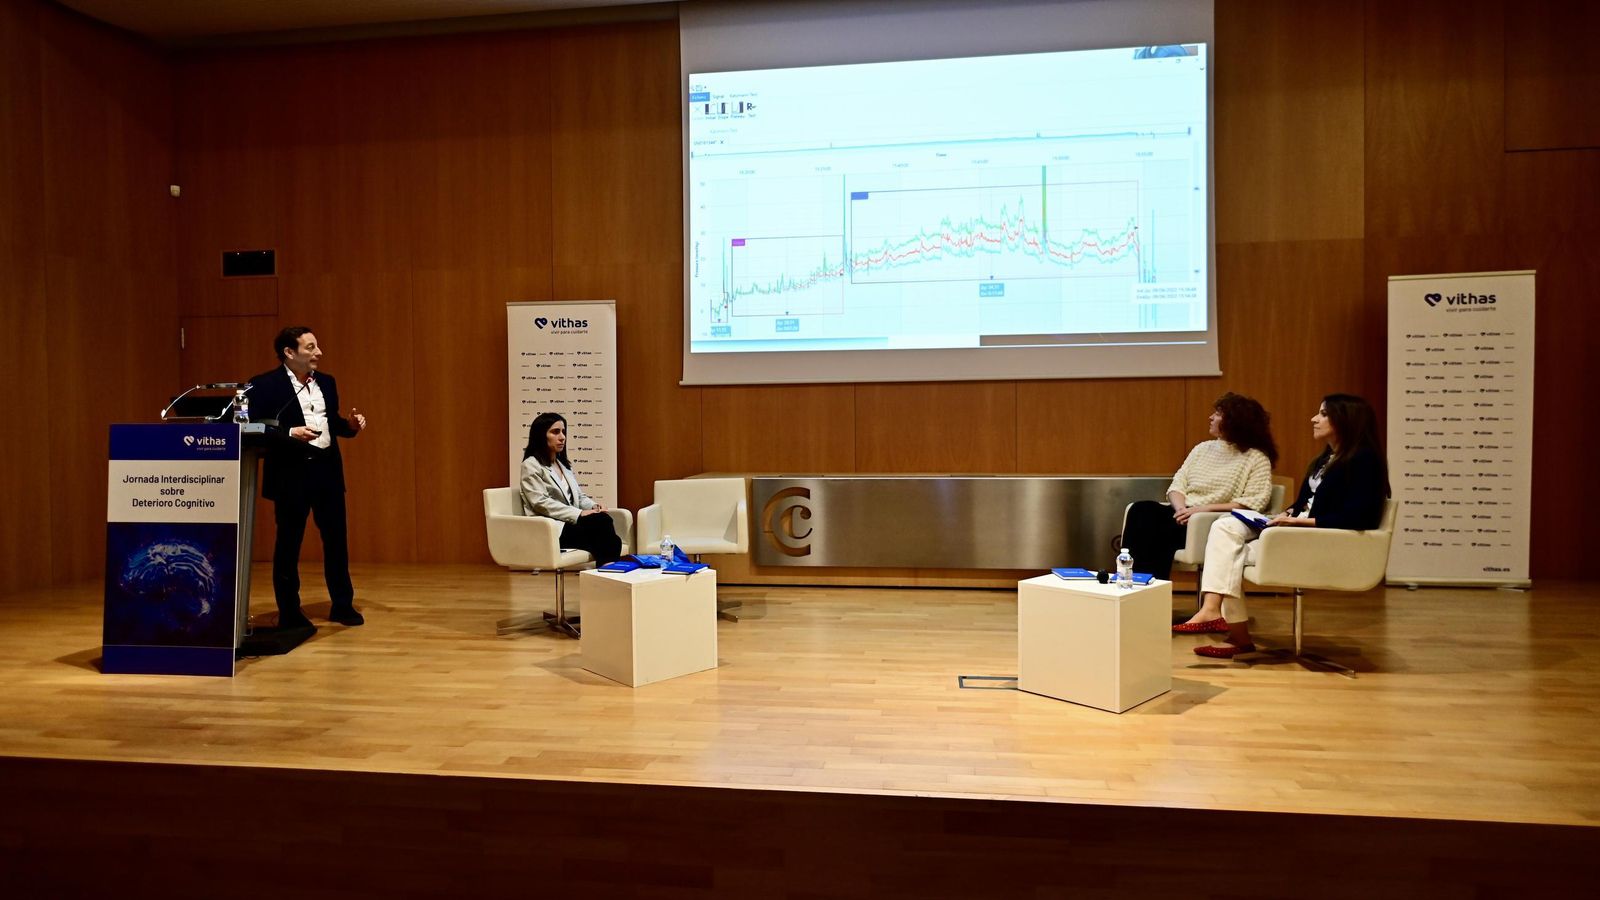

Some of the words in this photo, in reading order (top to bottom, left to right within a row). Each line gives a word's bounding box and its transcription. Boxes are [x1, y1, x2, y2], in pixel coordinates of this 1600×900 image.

[1446, 293, 1496, 305] vithas
[551, 318, 588, 328] vithas
[197, 436, 226, 445] vithas
[122, 475, 159, 484] Jornada
[161, 475, 225, 485] Interdisciplinar
[160, 487, 184, 495] sobre
[132, 498, 173, 507] Deterioro
[175, 499, 215, 509] Cognitivo
